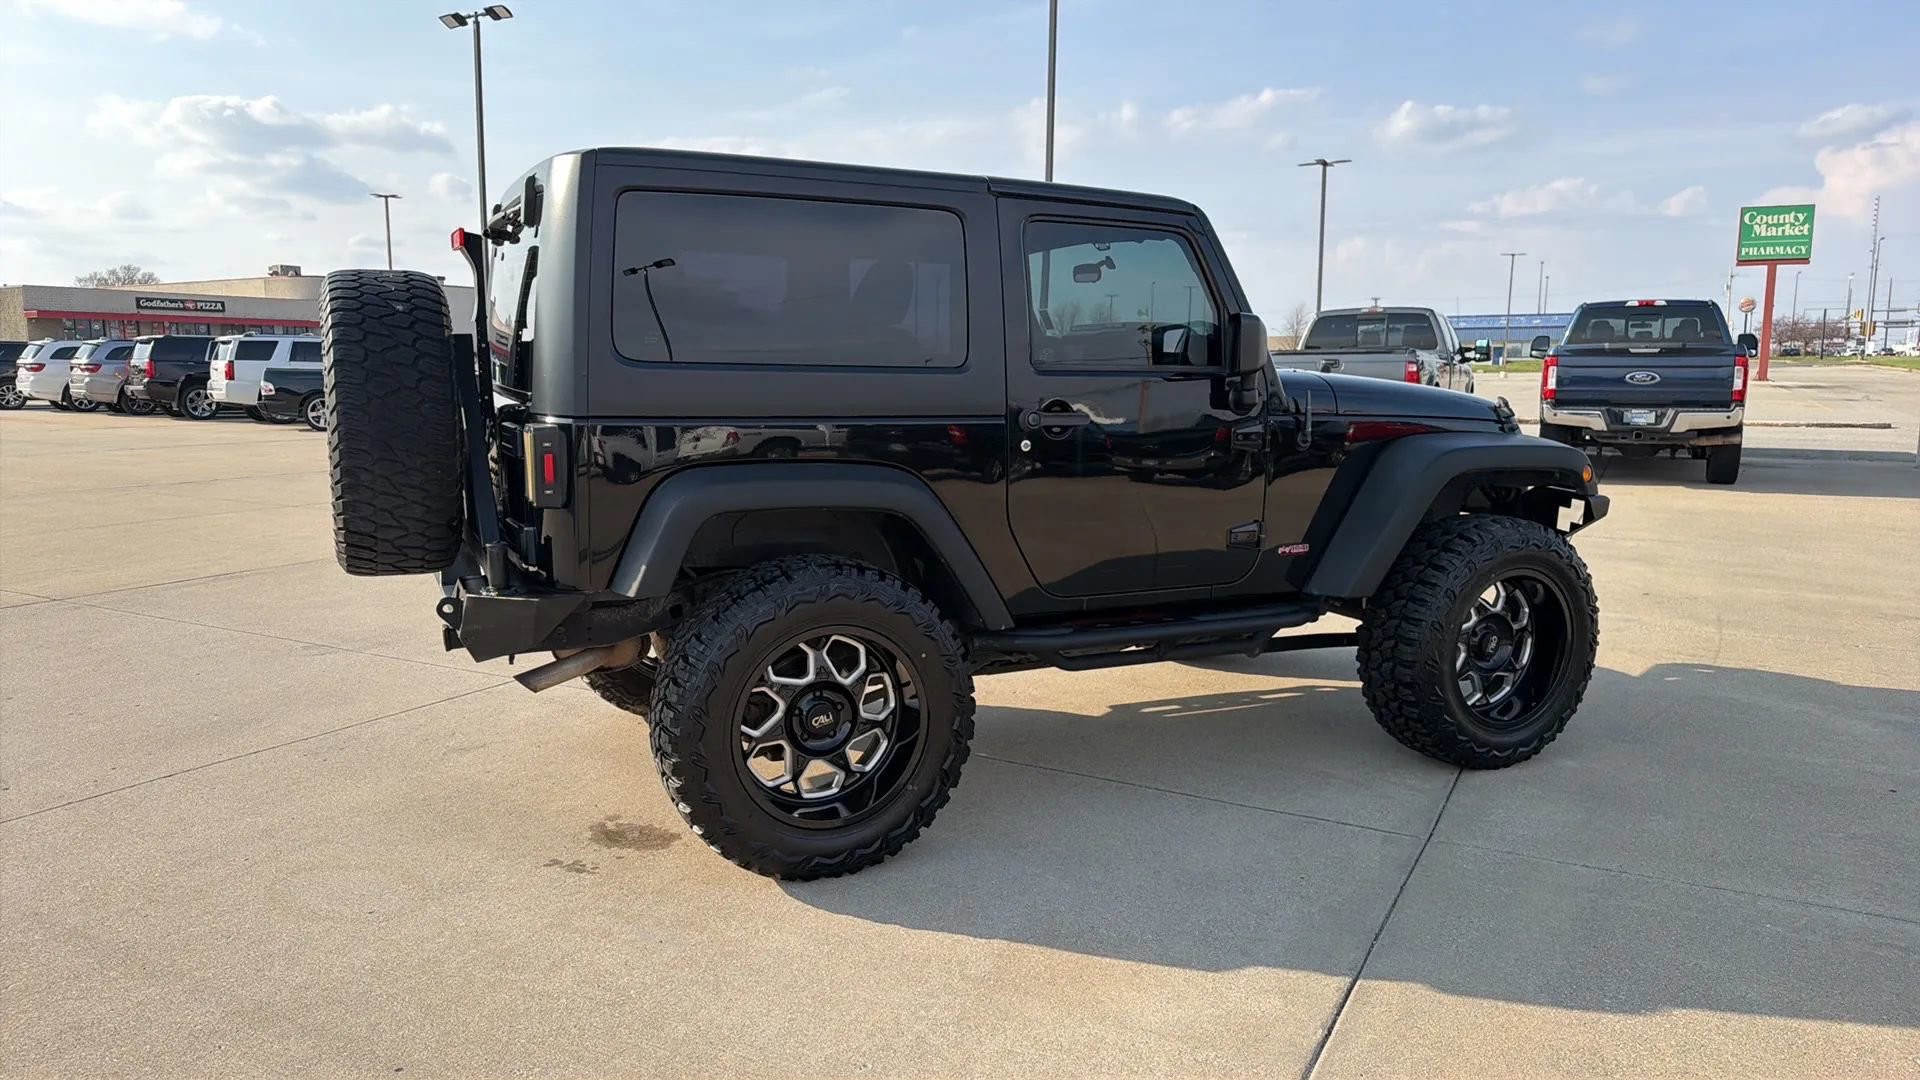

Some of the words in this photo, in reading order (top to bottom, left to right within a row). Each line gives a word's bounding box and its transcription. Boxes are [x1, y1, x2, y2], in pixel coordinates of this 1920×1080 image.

[1744, 211, 1808, 225] County
[1751, 223, 1810, 237] Market
[1741, 245, 1808, 256] PHARMACY
[140, 299, 183, 308] Godfather's
[197, 302, 223, 310] PIZZA
[811, 712, 834, 727] CALI
